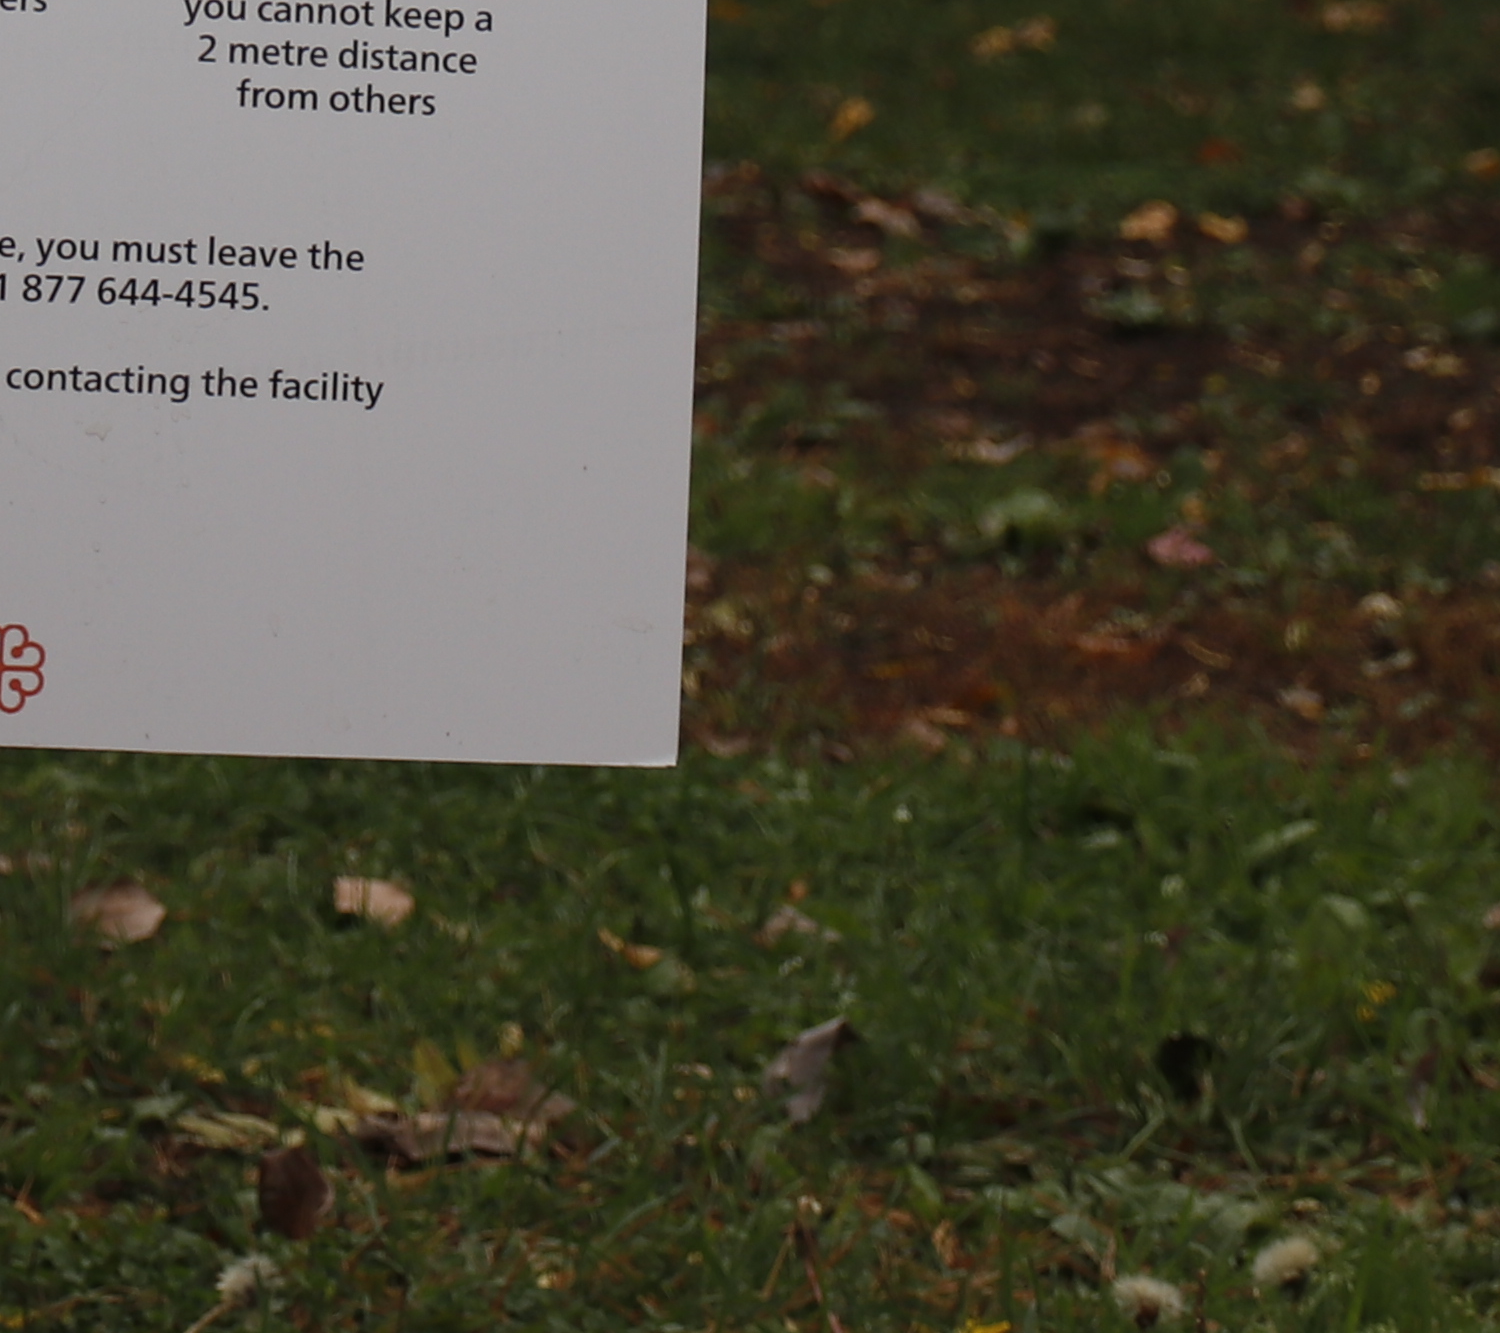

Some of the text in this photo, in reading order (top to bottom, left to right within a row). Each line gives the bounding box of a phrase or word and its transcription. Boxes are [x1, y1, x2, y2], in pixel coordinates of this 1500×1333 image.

[256, 0, 375, 28] cannot
[473, 10, 494, 33] a
[197, 33, 478, 75] 2 metre distance
[235, 77, 437, 117] from others
[35, 237, 100, 268] you
[111, 238, 198, 266] must
[207, 234, 299, 270] leave
[306, 239, 366, 273] the
[21, 273, 87, 305] 877
[96, 275, 270, 312] 644-4545.
[5, 364, 191, 404] contacting
[200, 366, 259, 399] the
[267, 368, 385, 412] facility
